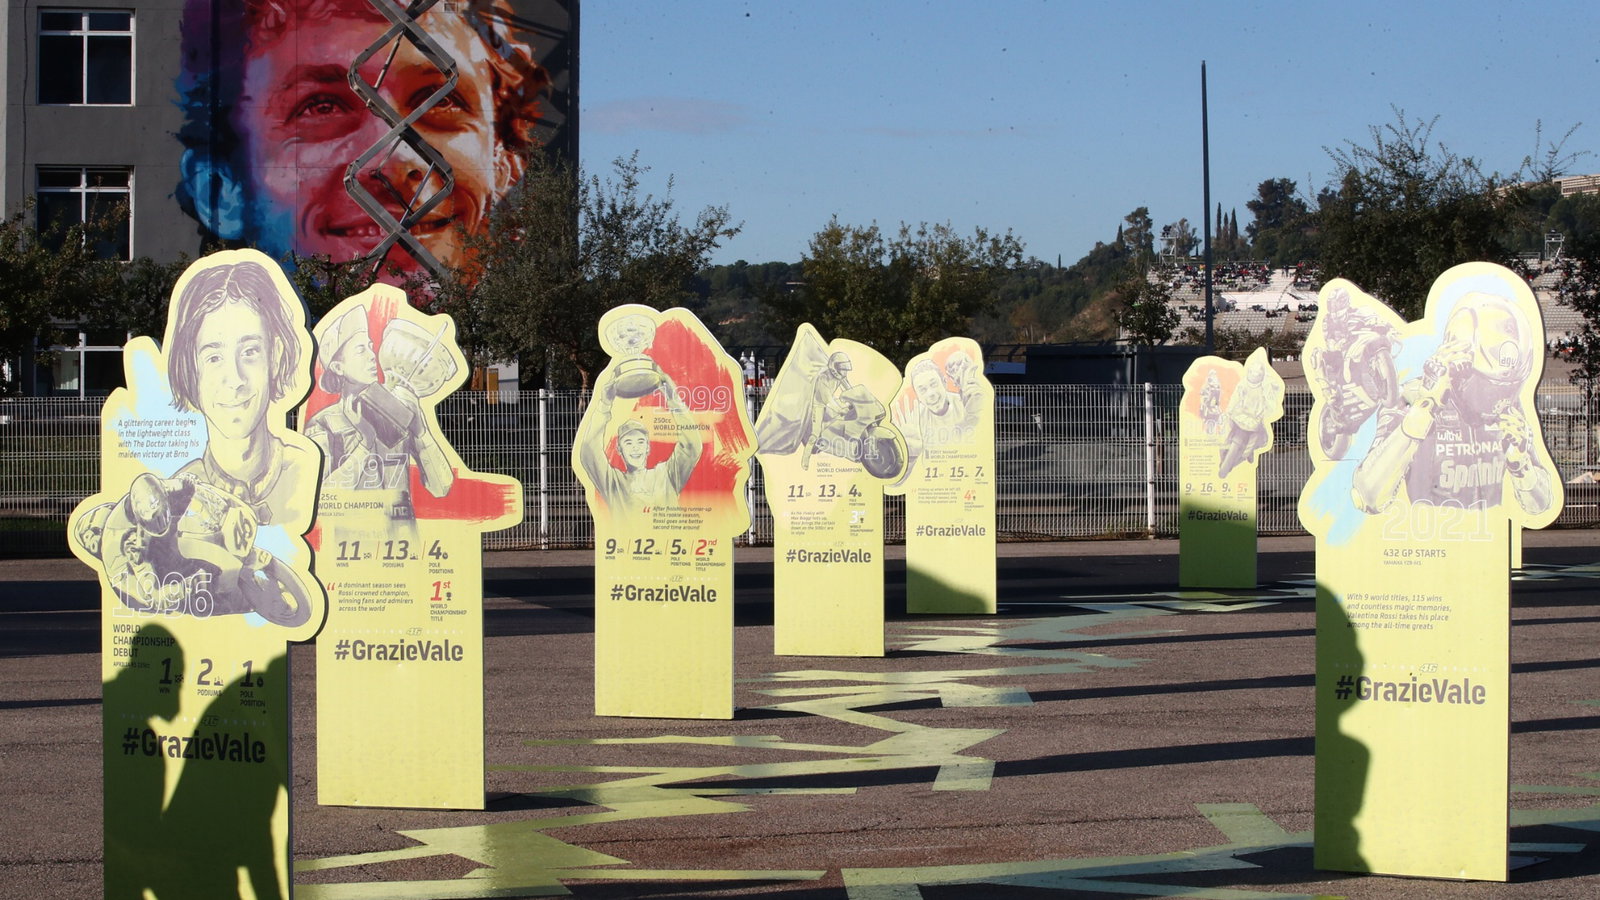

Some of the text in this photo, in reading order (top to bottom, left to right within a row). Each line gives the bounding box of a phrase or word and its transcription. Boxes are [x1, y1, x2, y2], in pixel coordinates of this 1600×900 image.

[652, 385, 732, 414] 1999
[124, 419, 153, 428] glittering
[176, 418, 197, 428] begins
[137, 430, 173, 438] lightweight
[118, 440, 200, 449] with The Doctor taking his
[816, 436, 878, 460] 2001
[118, 450, 188, 460] maiden victory at Brno
[322, 452, 409, 489] 1997
[924, 466, 982, 478] 11 15 7
[788, 484, 858, 498] 11 13 4
[1200, 482, 1213, 492] 16
[344, 502, 384, 510] CHAMPION
[1188, 510, 1248, 520] #GrazieVale
[1382, 498, 1493, 542] 2021
[916, 524, 986, 536] #GrazieVale
[336, 540, 442, 560] 11 13 4
[606, 538, 718, 556] 9 12 5 2nd
[786, 549, 872, 564] #GrazieVale
[1384, 548, 1446, 558] 432 GP STARTS
[111, 571, 214, 620] 1996
[610, 584, 717, 602] #GrazieVale
[1390, 594, 1410, 602] titles,
[1394, 604, 1415, 612] magic
[1416, 604, 1452, 612] memories,
[1346, 612, 1448, 622] Valentino Rossi takes his place
[113, 624, 141, 634] WORLD
[1346, 622, 1370, 630] among
[1384, 622, 1410, 630] all-time
[1412, 623, 1434, 631] greats
[113, 636, 176, 647] CHAMPIONSHIP
[113, 648, 139, 658] DEBUT
[334, 639, 464, 662] #GrazieVale
[159, 658, 254, 687] 1 2 1
[1335, 676, 1486, 705] #GrazieVale
[240, 700, 266, 708] POSITION
[122, 727, 266, 763] #GrazieVale
